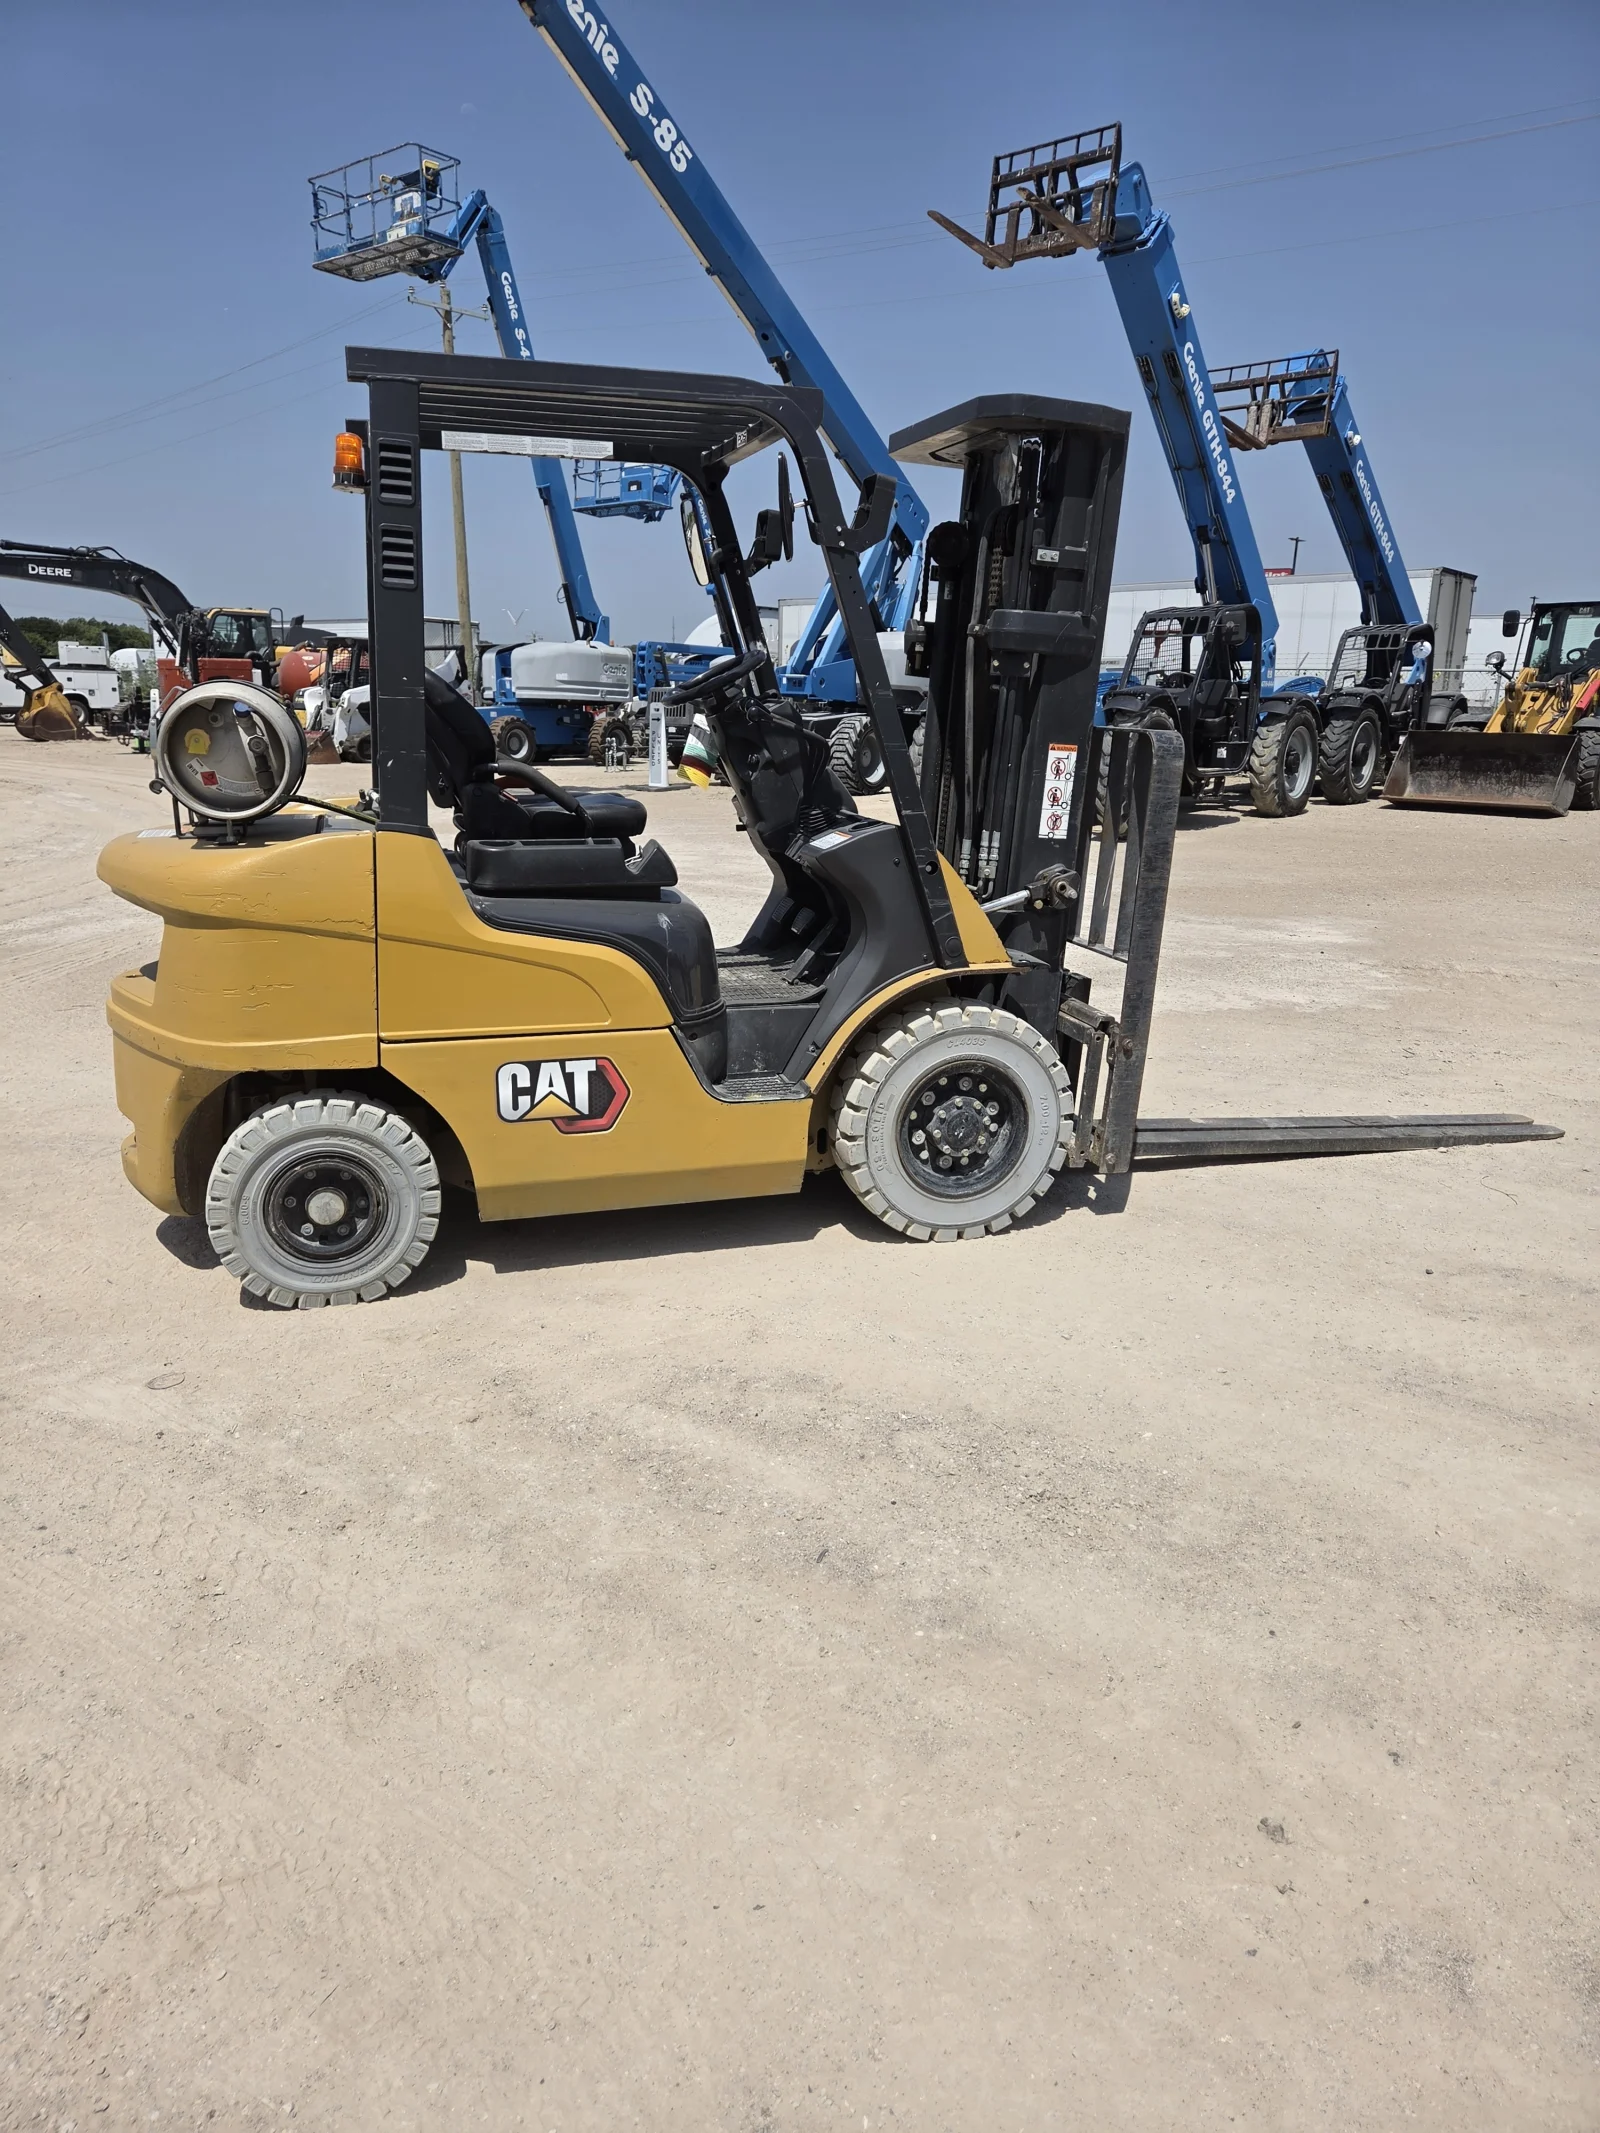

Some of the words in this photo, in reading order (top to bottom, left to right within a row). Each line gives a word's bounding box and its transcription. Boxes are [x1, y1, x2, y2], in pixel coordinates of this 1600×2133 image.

[566, 0, 620, 76] enie
[630, 83, 693, 173] S-85
[501, 271, 518, 322] Genie
[514, 327, 531, 360] S-4
[1183, 341, 1205, 411] Genie
[1202, 409, 1236, 504] GTH-844
[698, 499, 707, 525] Genie
[1356, 459, 1371, 506] Genie
[1370, 500, 1394, 563] GTH-844
[28, 563, 72, 578] DEERE
[603, 662, 627, 676] Genie
[497, 1059, 597, 1121] CAT
